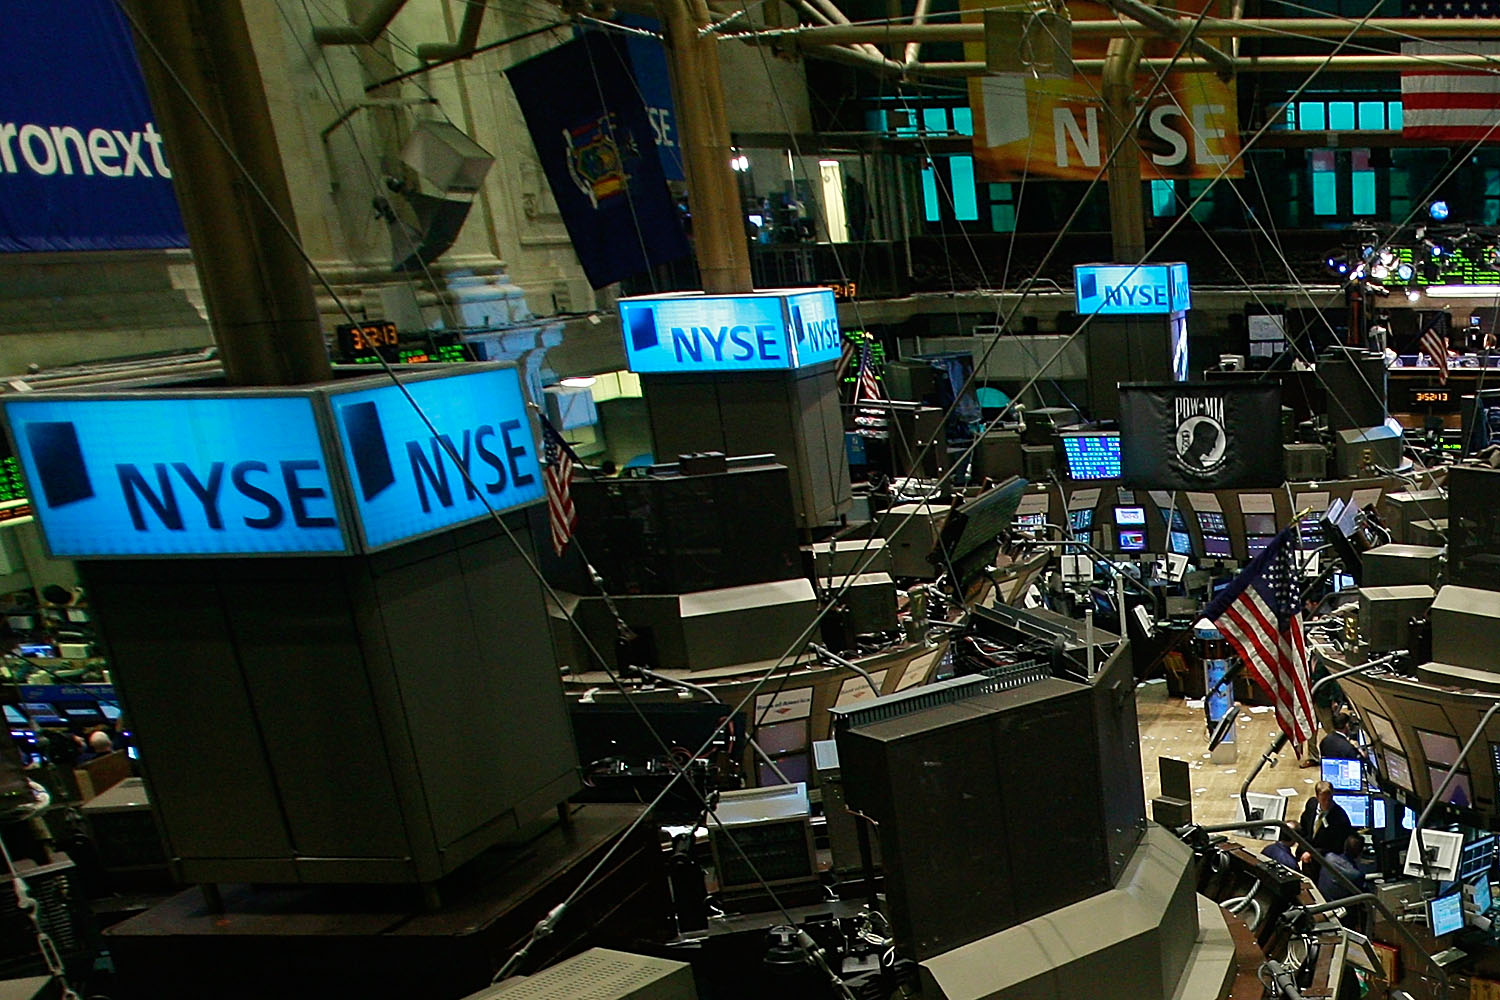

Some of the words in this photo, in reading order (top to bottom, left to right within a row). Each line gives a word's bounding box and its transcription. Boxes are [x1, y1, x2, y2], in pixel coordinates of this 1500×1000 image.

[0, 122, 173, 179] ronext
[1052, 104, 1230, 167] NSE
[1105, 285, 1167, 306] NYSE
[671, 325, 781, 363] NYSE
[807, 318, 840, 353] NYSE
[405, 418, 534, 514] NYSE
[115, 459, 336, 532] NYSE
